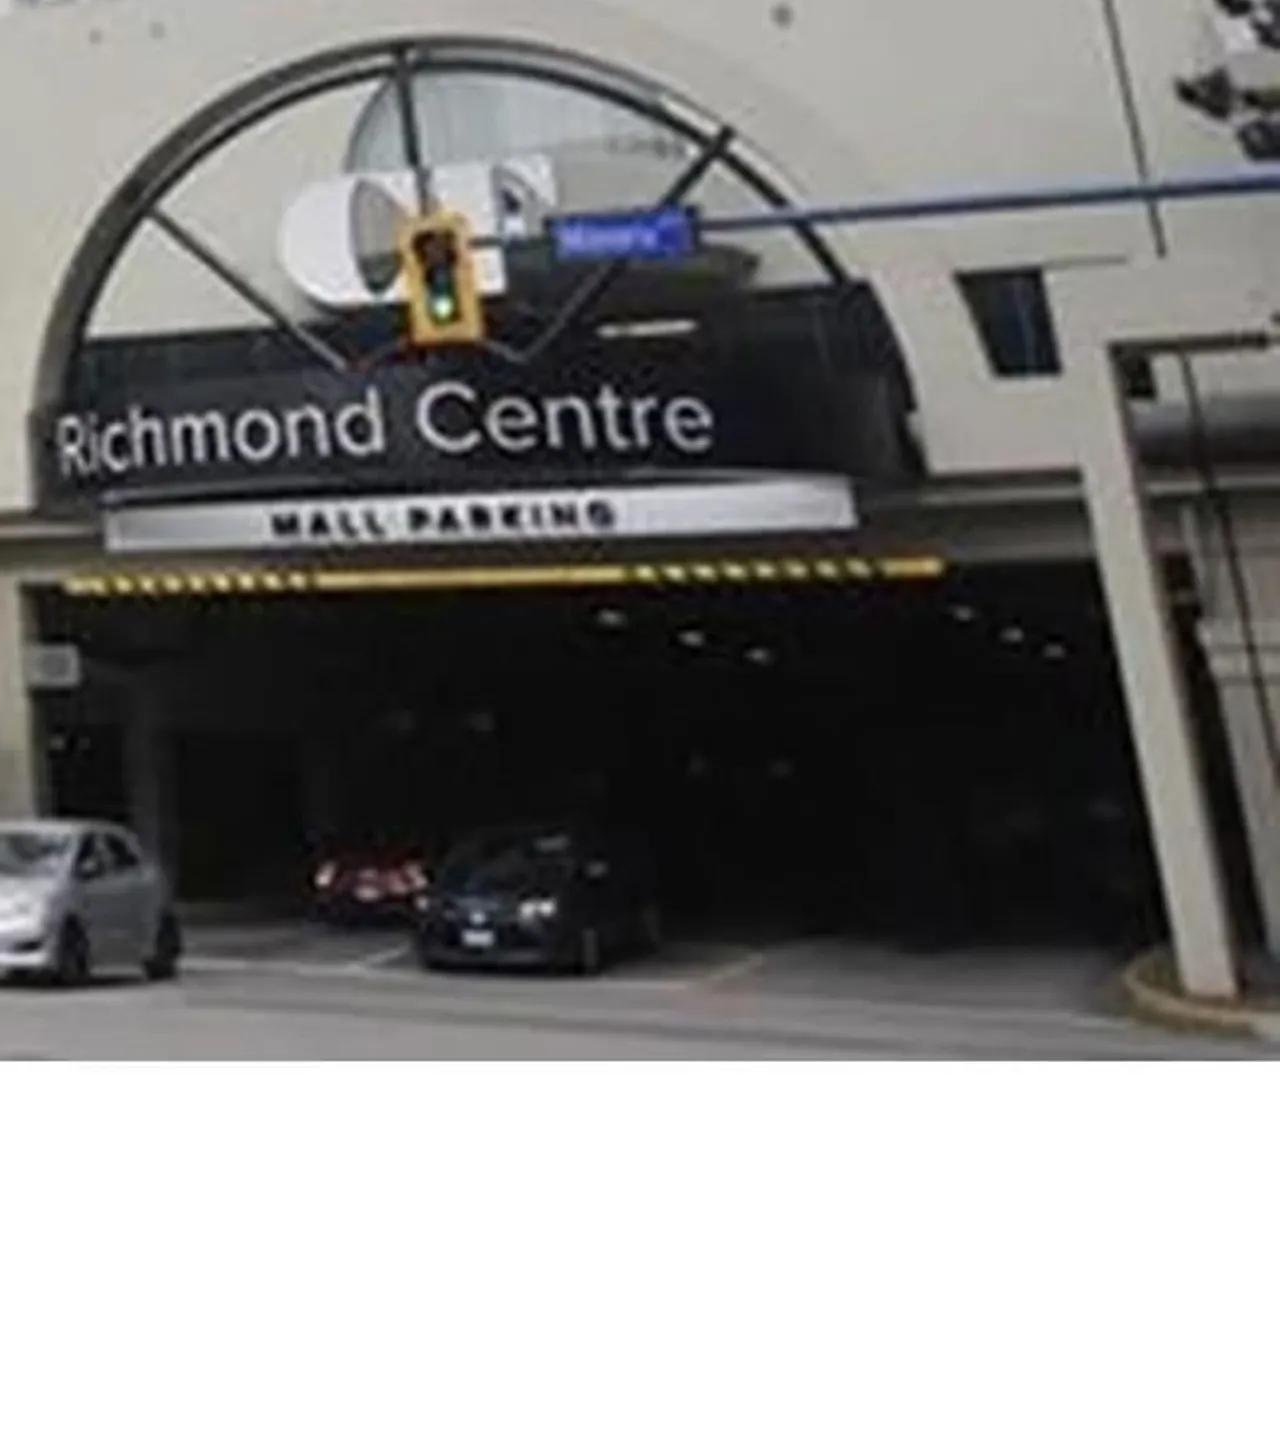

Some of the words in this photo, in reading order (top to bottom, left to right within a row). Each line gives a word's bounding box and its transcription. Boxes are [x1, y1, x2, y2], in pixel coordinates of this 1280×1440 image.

[57, 384, 385, 477] Richmond
[416, 380, 713, 453] Centre
[270, 510, 385, 538] MALL
[406, 499, 616, 532] PARKING
